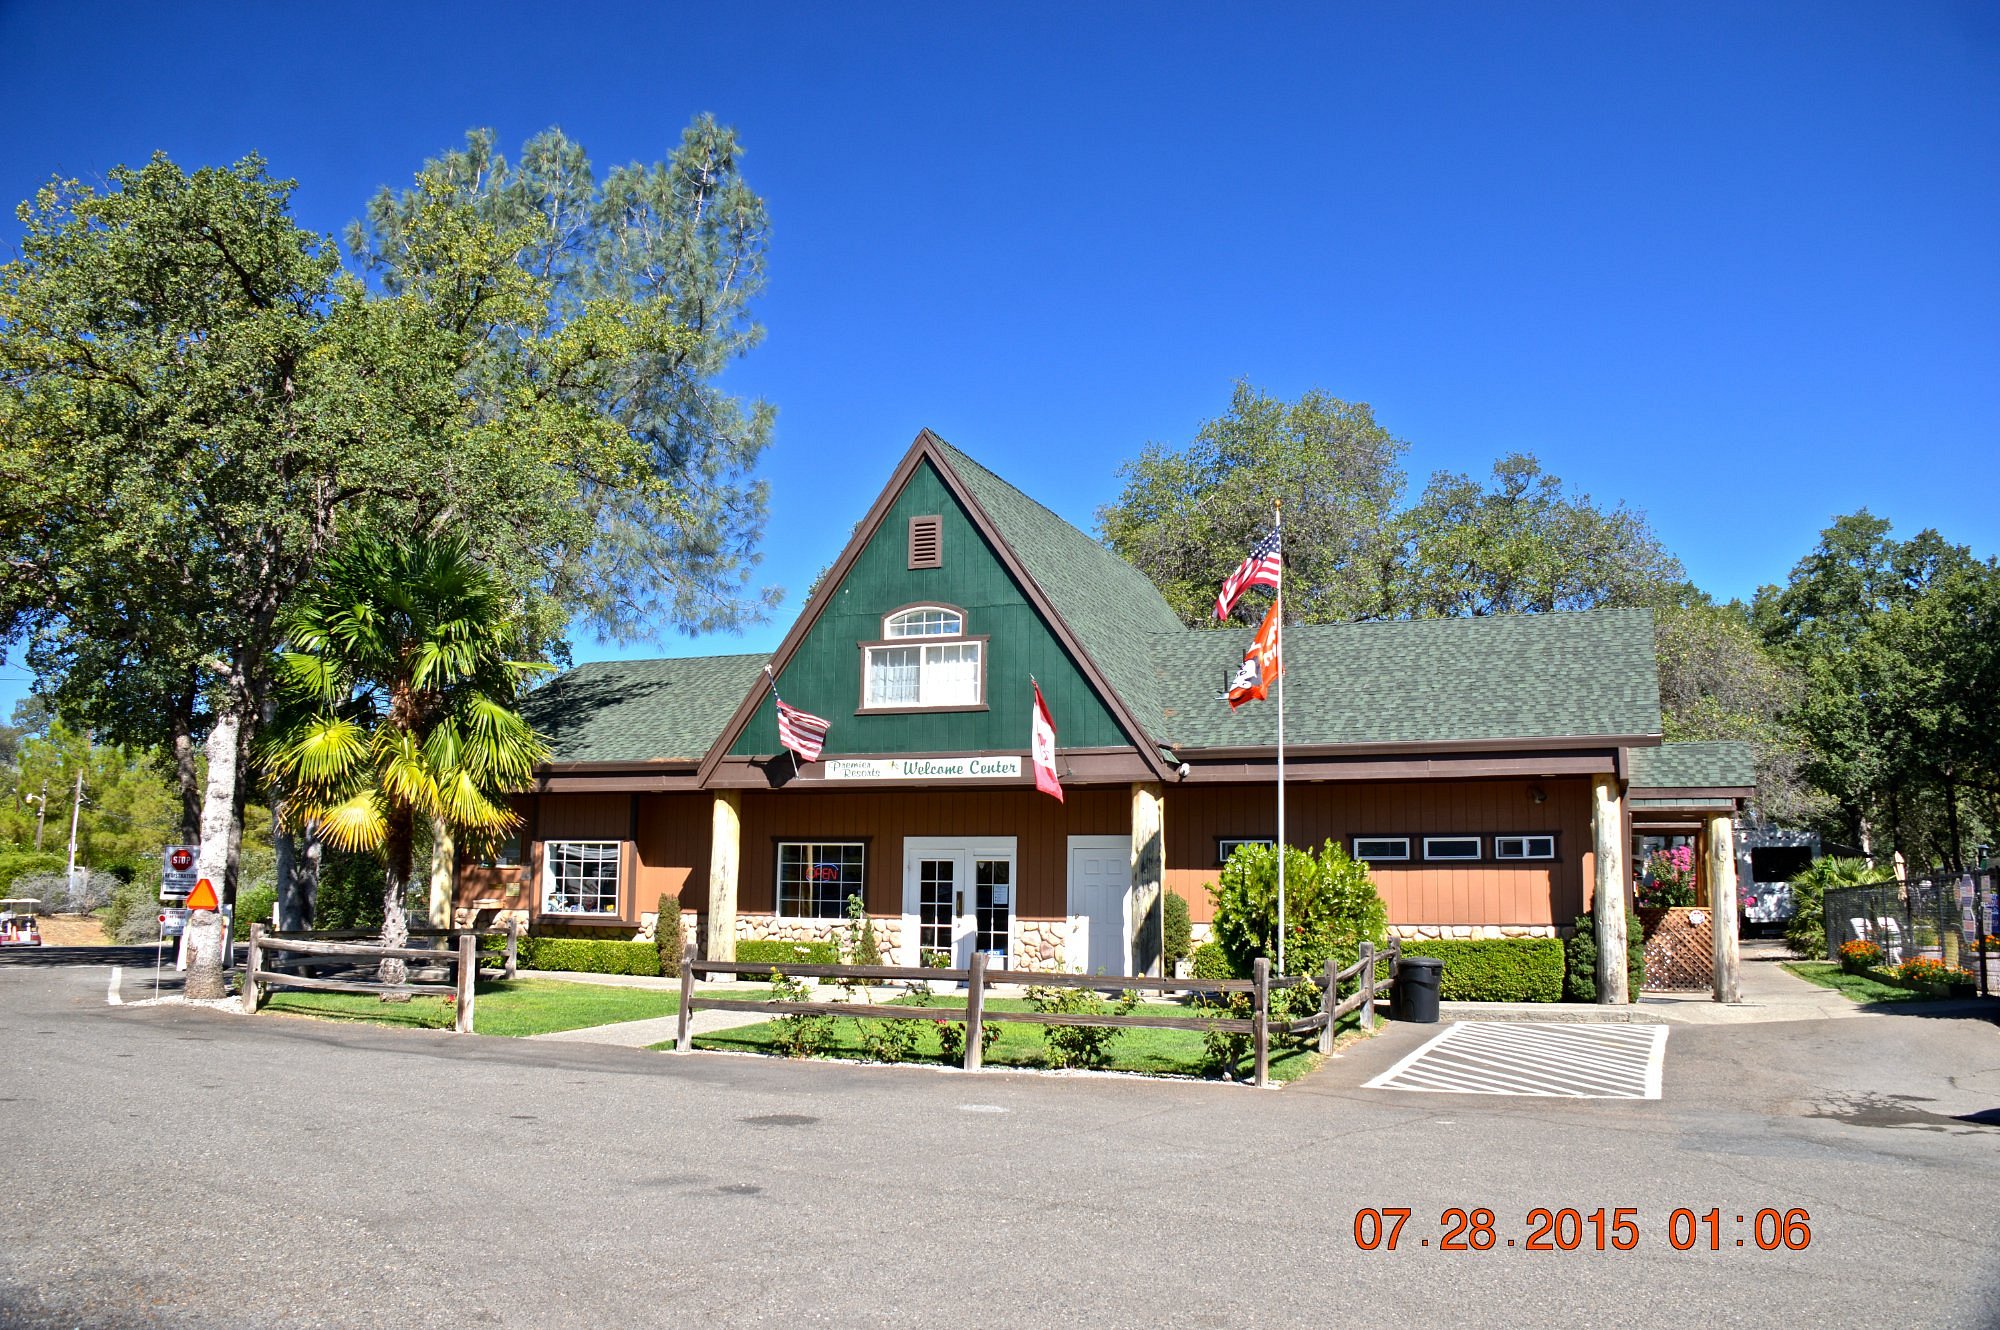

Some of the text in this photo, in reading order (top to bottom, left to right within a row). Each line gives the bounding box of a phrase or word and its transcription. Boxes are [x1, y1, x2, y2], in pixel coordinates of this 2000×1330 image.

[903, 760, 1018, 776] Welcome Center
[172, 856, 191, 864] STOP
[805, 867, 837, 880] OPEN
